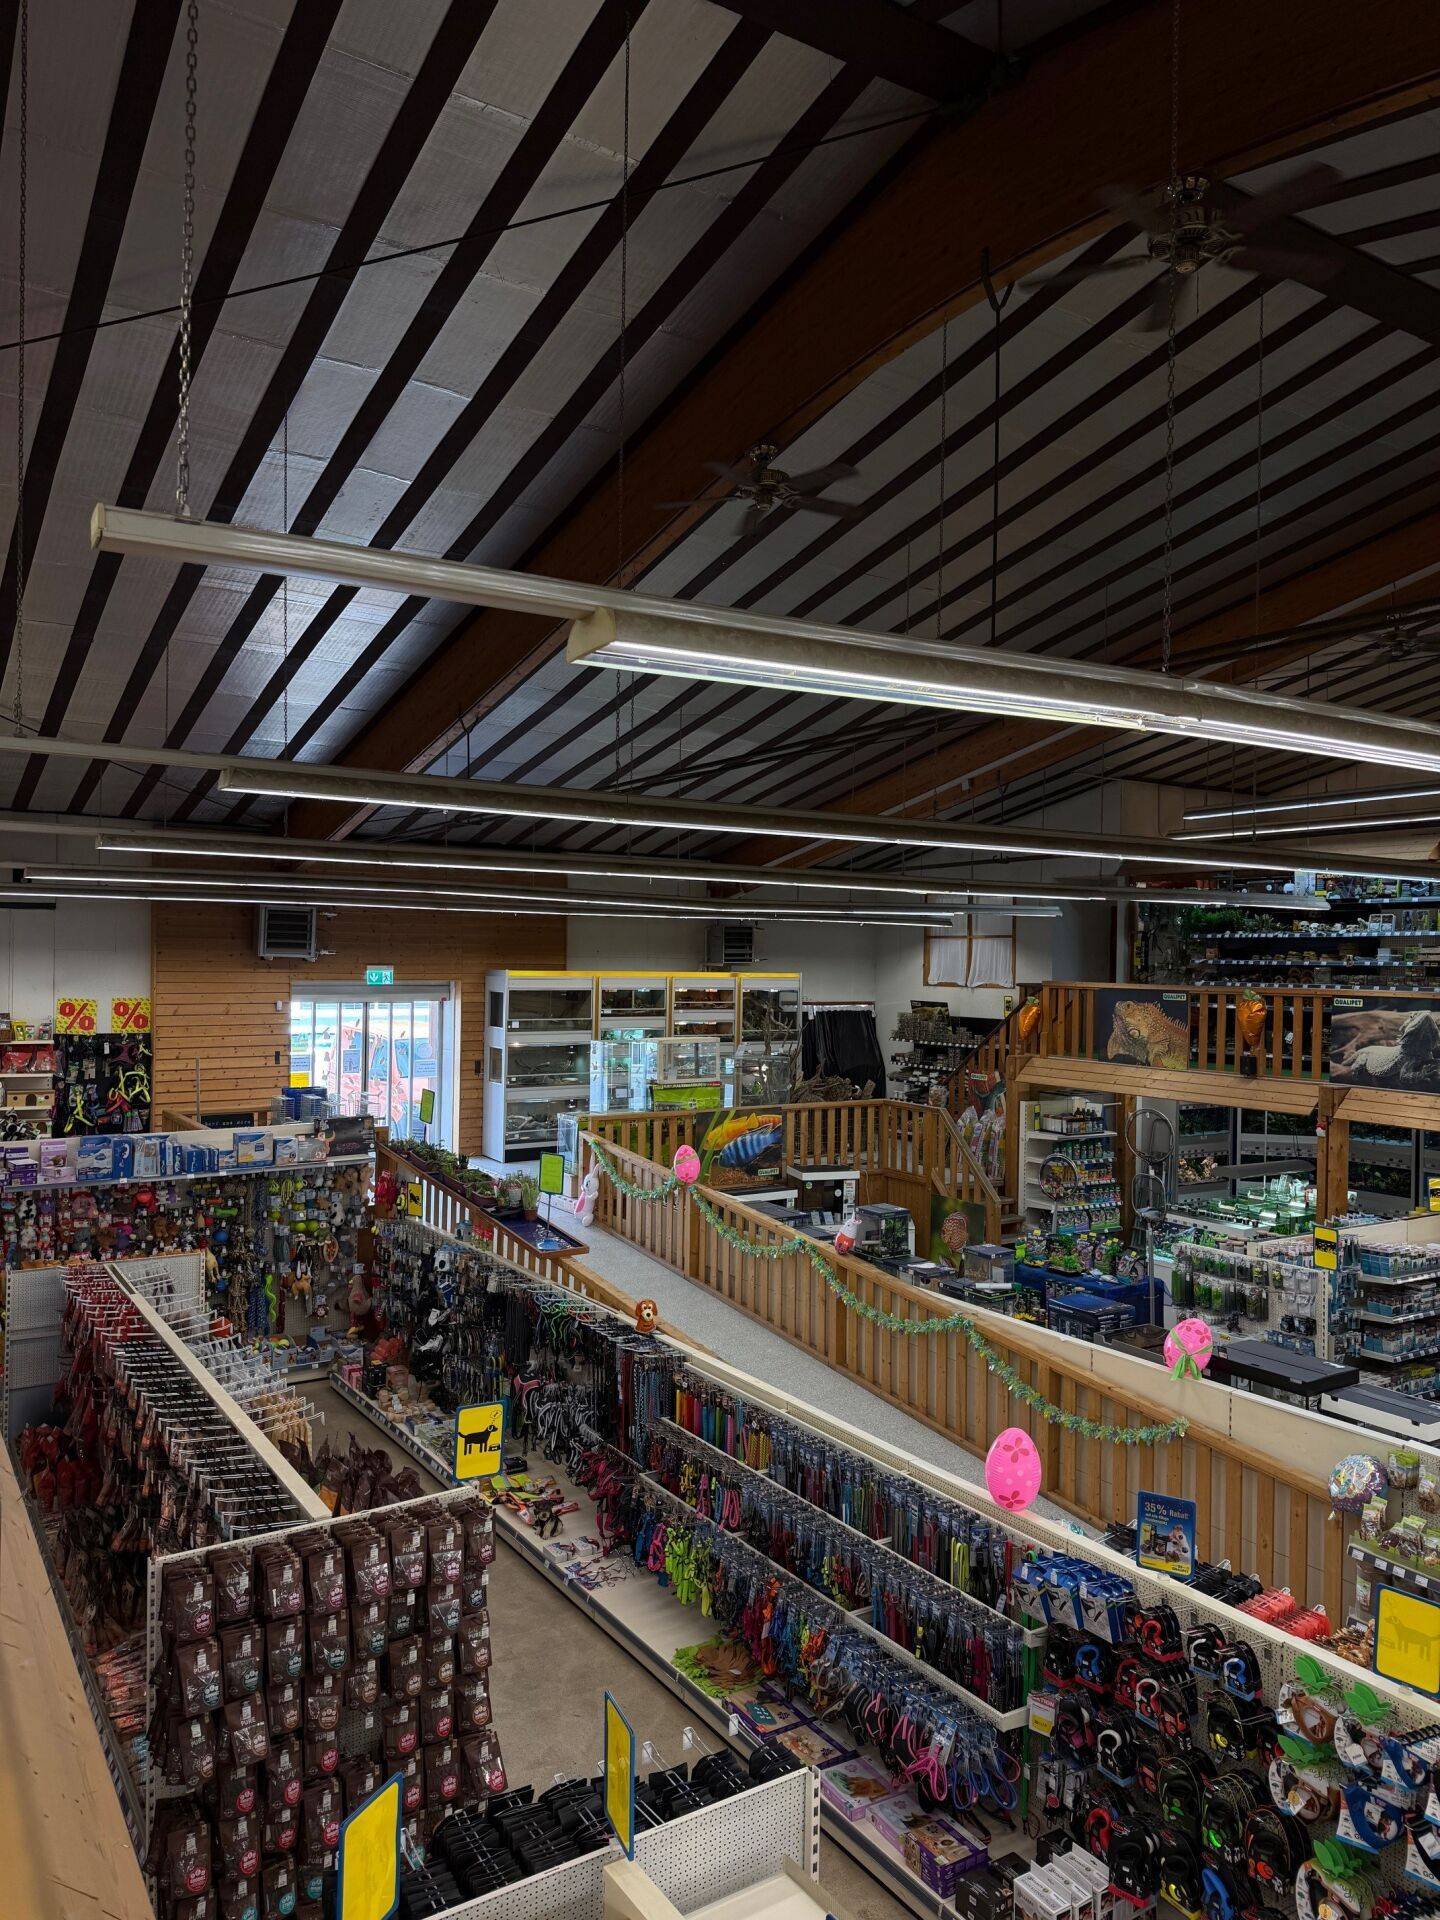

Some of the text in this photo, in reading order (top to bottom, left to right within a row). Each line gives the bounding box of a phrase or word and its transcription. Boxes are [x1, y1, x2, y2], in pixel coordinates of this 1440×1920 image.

[1144, 1502, 1167, 1516] 35%
[364, 1559, 379, 1567] PURE
[321, 1630, 337, 1638] PURE
[280, 1639, 296, 1647] PURE
[193, 1664, 210, 1674] PURE
[316, 1687, 331, 1695] PURE
[241, 1717, 256, 1726] PURE
[191, 1737, 205, 1746] PURE
[480, 1755, 493, 1764] PURE
[180, 1849, 197, 1857] PURE
